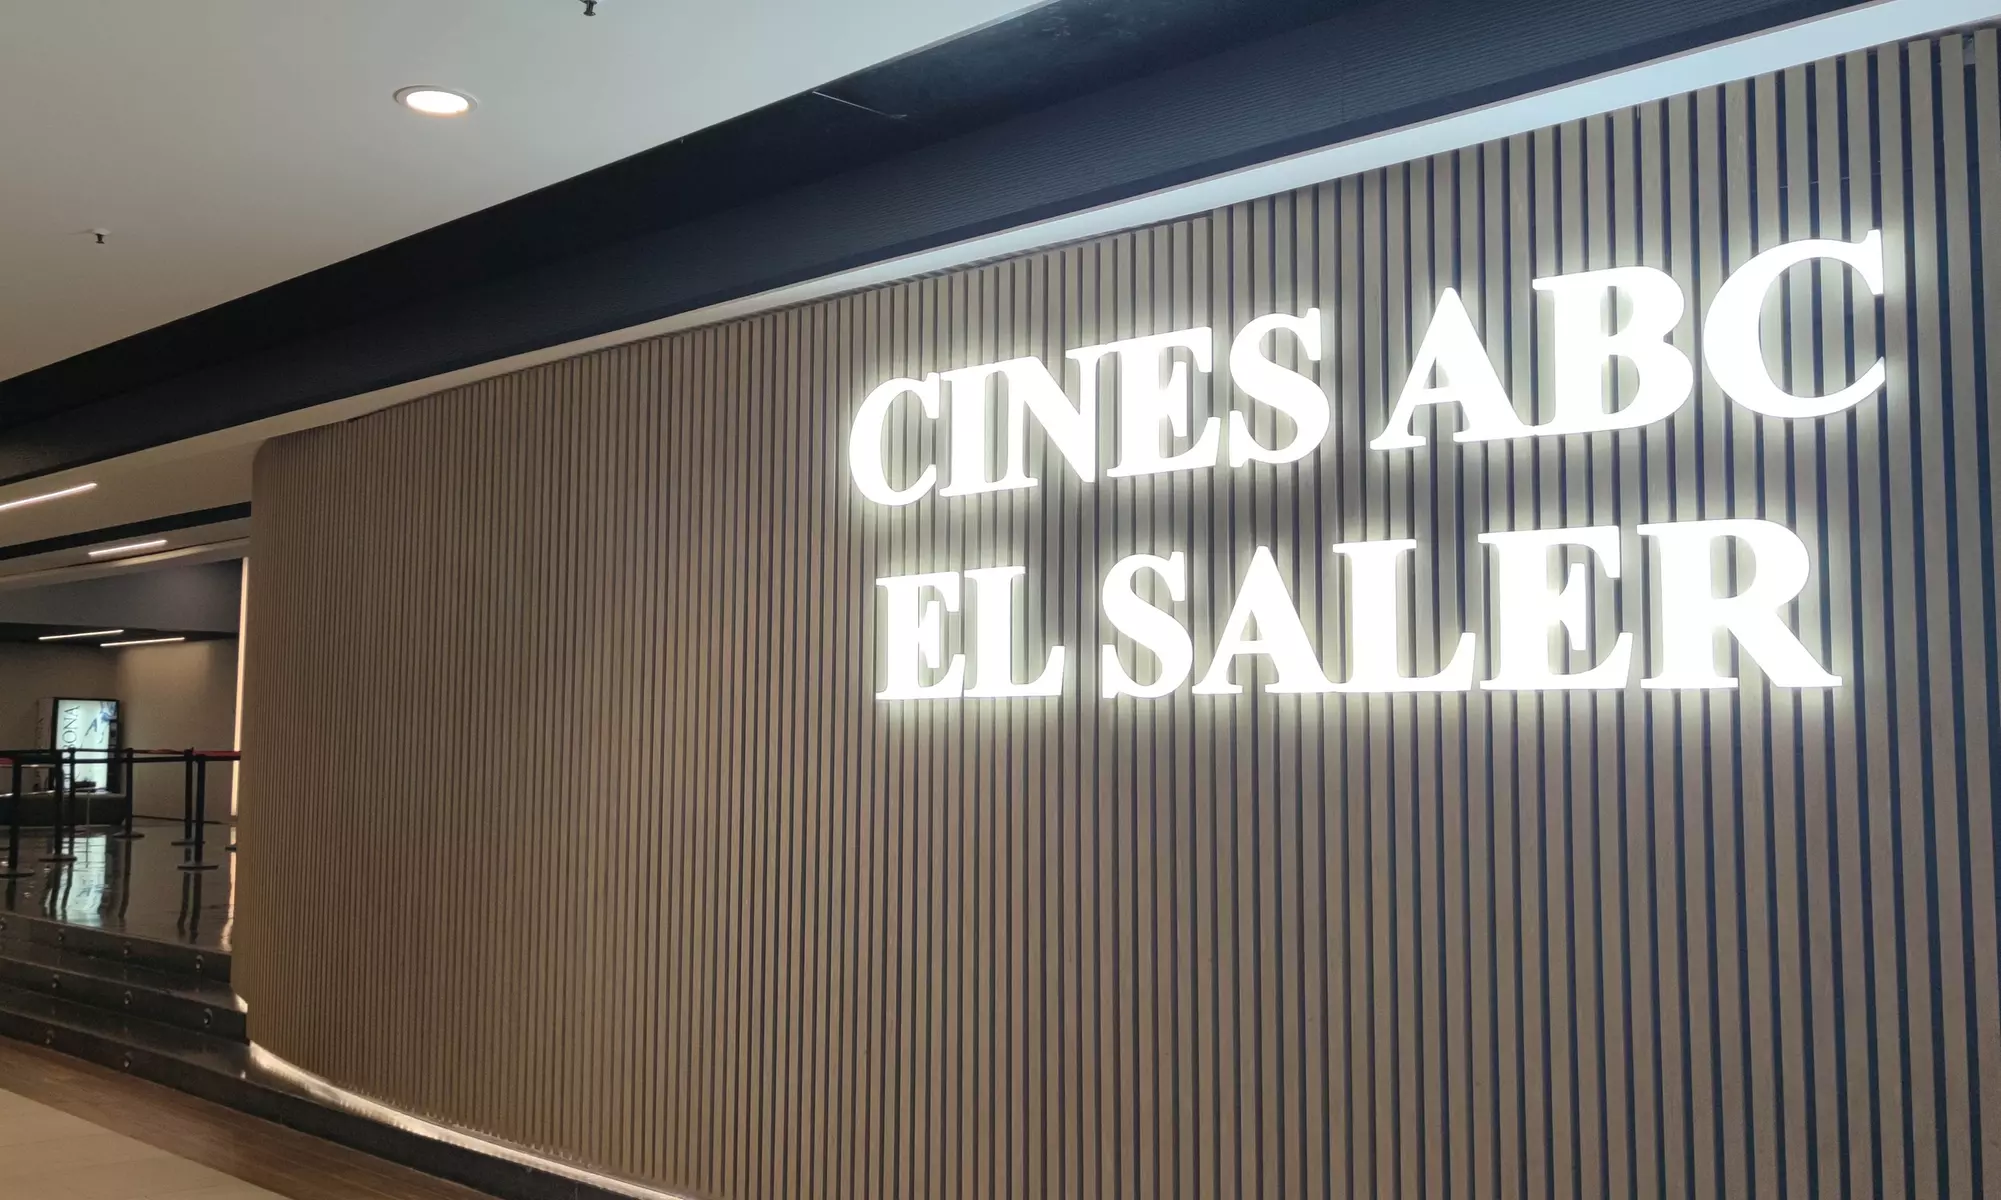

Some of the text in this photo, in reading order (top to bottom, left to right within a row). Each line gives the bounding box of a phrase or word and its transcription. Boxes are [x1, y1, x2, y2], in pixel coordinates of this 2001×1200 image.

[849, 229, 1886, 506] CINES ABC
[876, 518, 1843, 700] EL SALER
